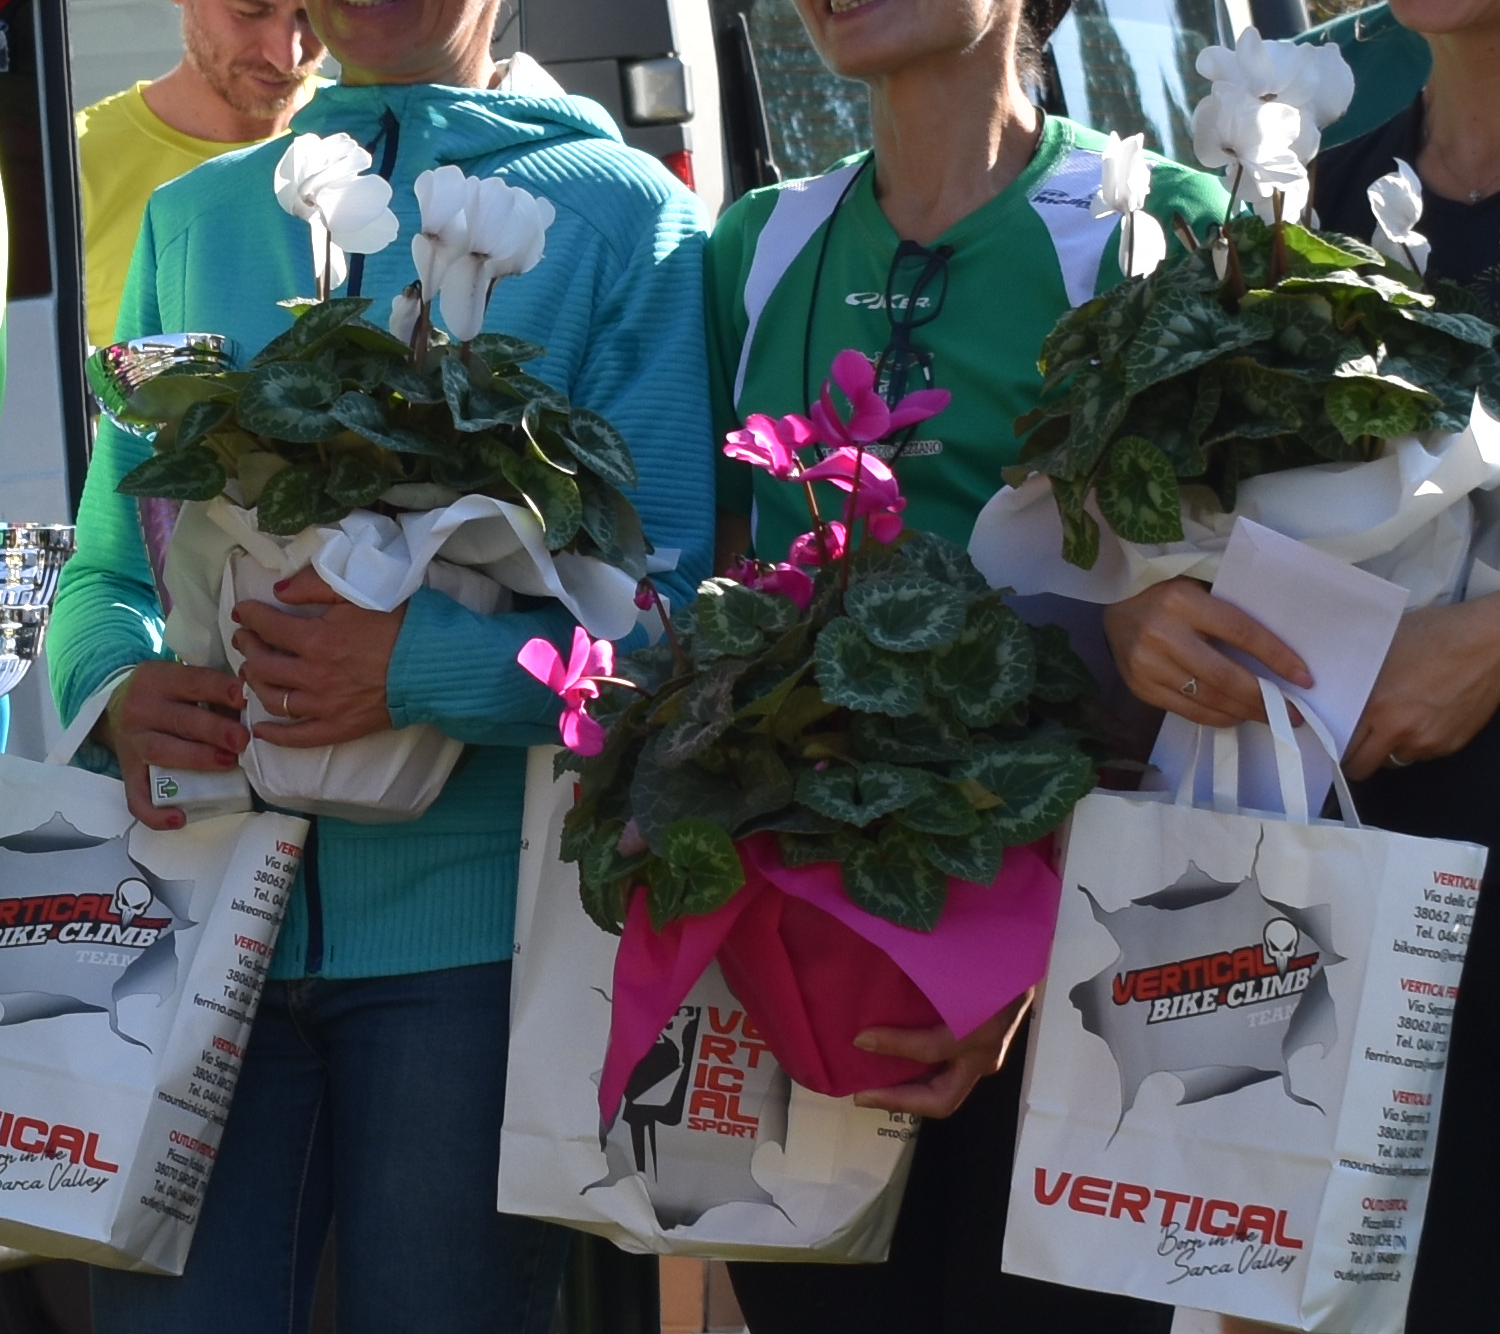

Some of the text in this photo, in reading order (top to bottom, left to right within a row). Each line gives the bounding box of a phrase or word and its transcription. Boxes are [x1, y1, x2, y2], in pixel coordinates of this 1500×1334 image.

[265, 855, 281, 869] Via
[254, 870, 285, 889] 38062
[254, 887, 270, 903] Tel.
[1424, 889, 1441, 903] Via
[1414, 906, 1450, 924] 38062
[57, 922, 160, 947] CLIMB
[1416, 925, 1435, 939] Tel.
[239, 954, 252, 968] Via
[1112, 944, 1277, 1005] VERTICAL
[1149, 967, 1311, 1022] BIKE CLIMB
[1407, 998, 1425, 1013] Via
[687, 1117, 758, 1139] SPORT
[20, 1147, 38, 1163] in
[48, 1162, 109, 1193] Valley
[1034, 1167, 1303, 1250] VERTICAL
[1157, 1222, 1203, 1256] Born
[1208, 1234, 1228, 1247] in
[1166, 1244, 1296, 1284] Sarca Valley
